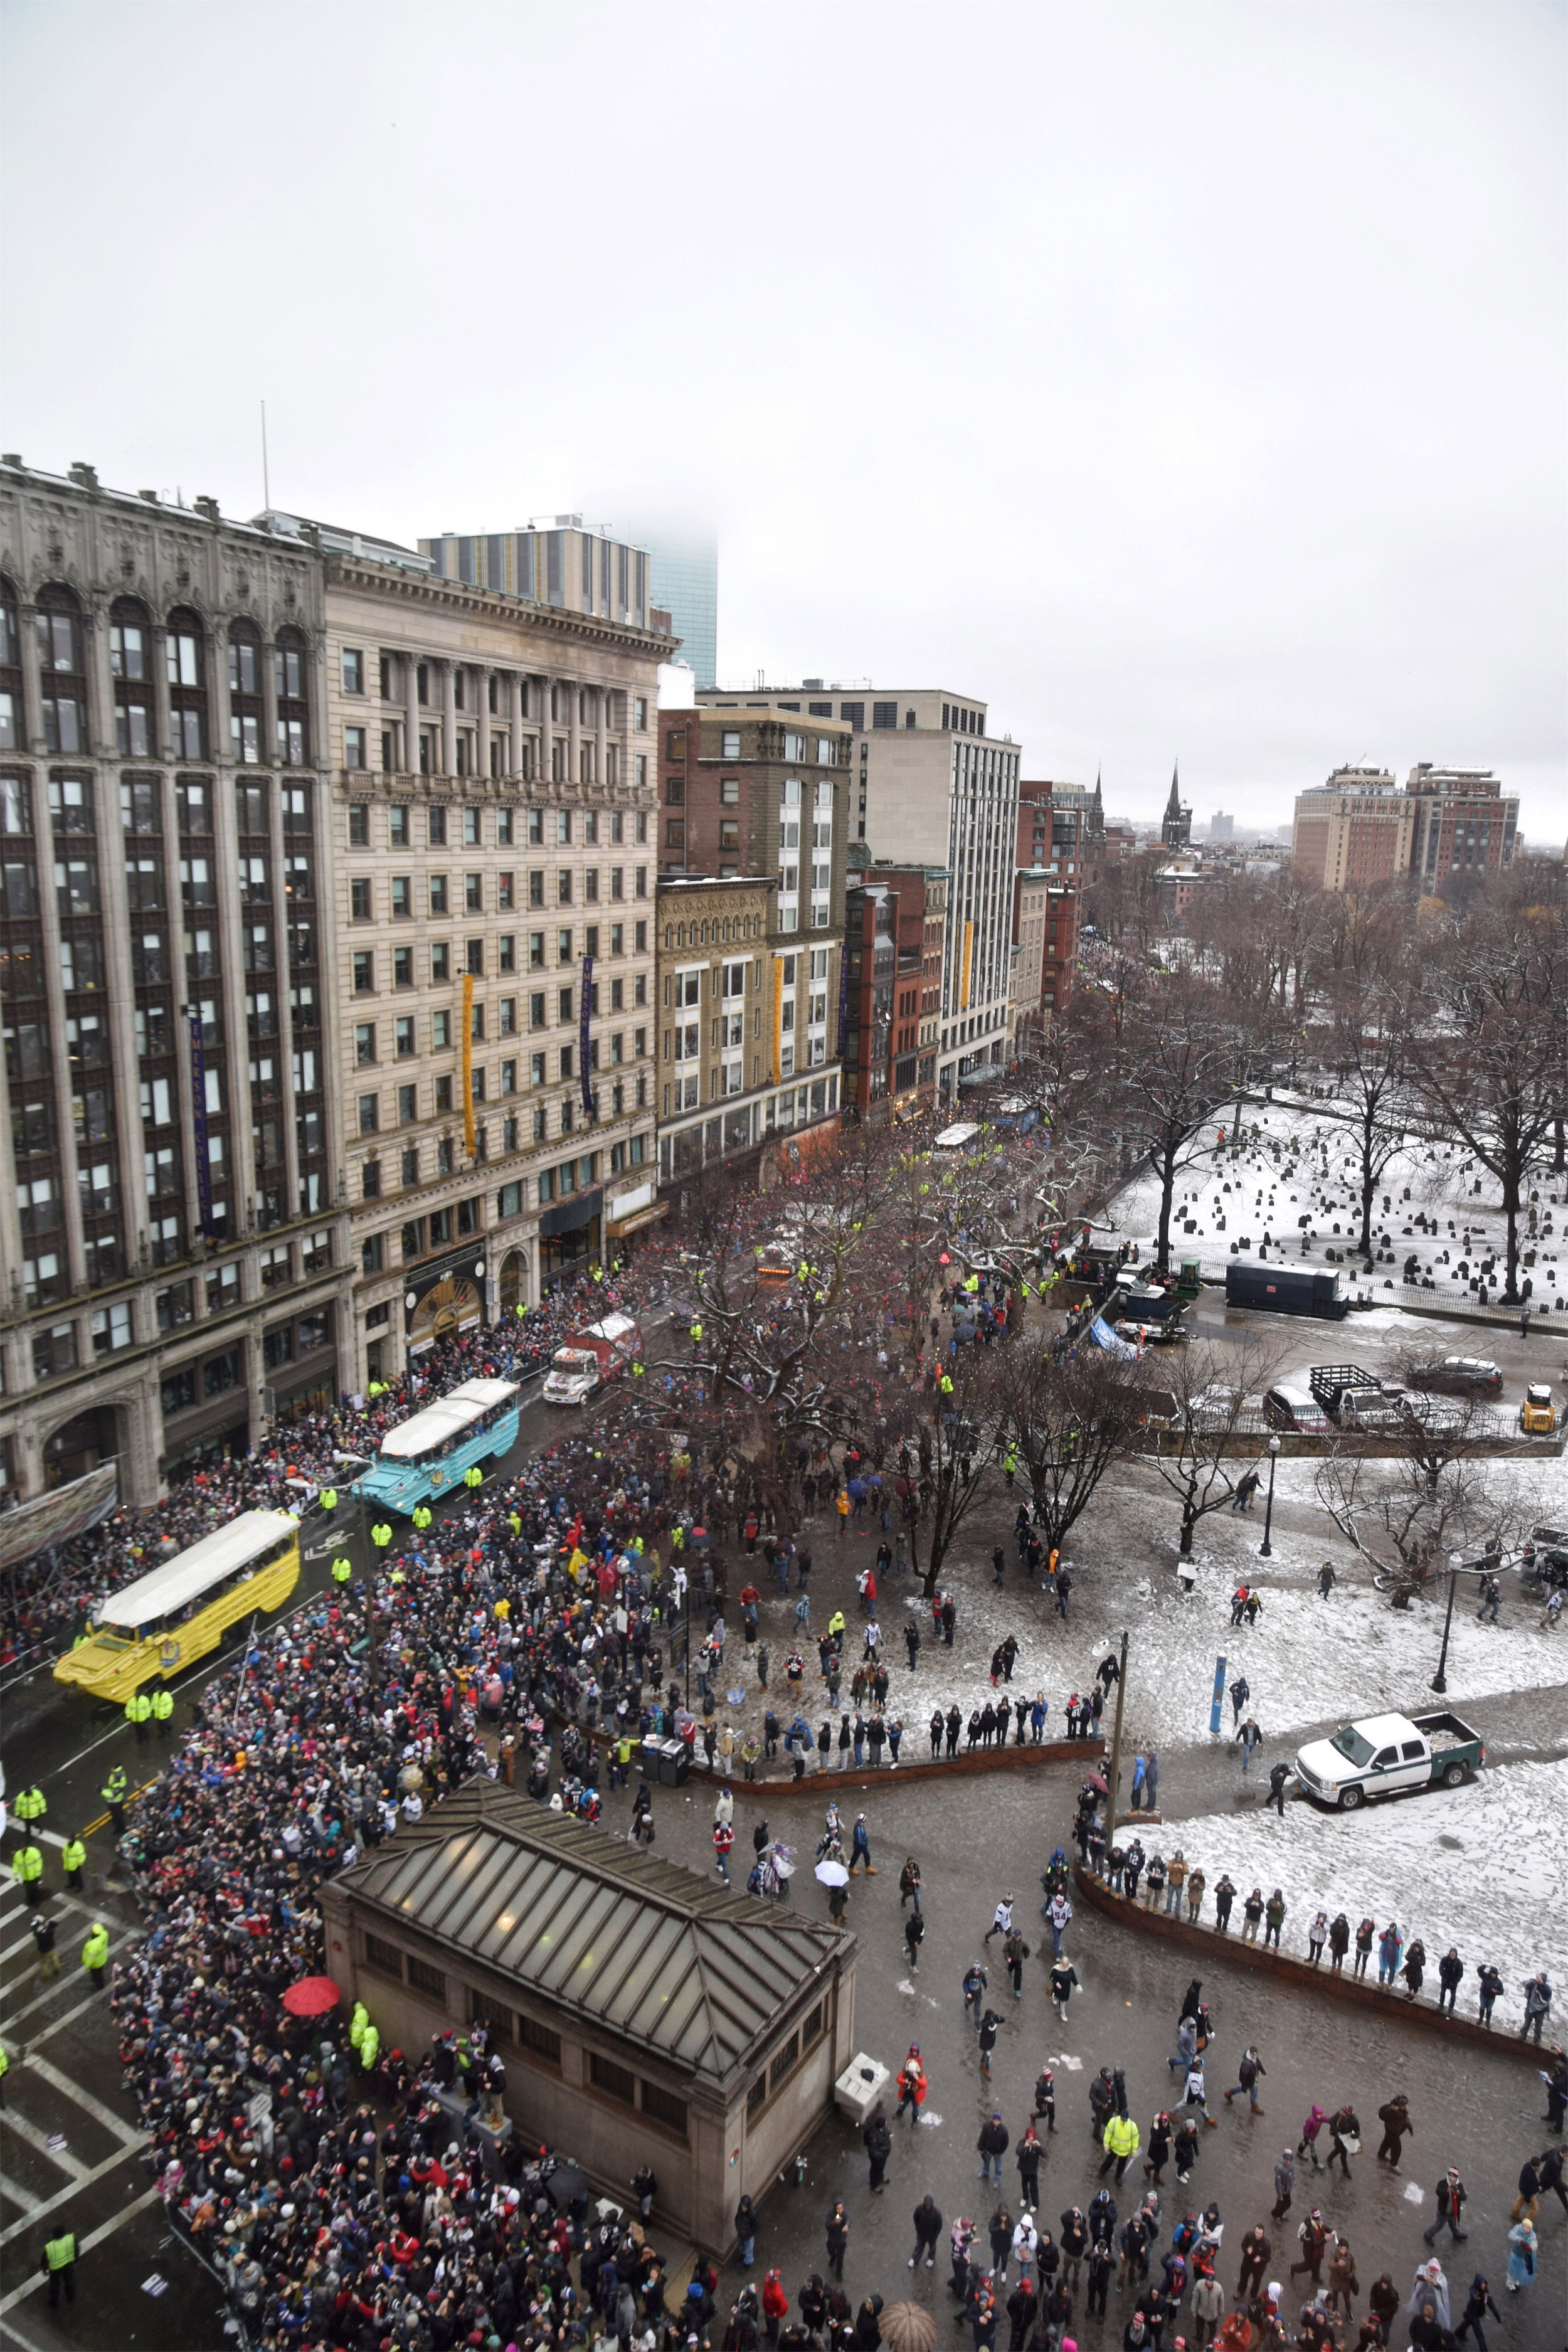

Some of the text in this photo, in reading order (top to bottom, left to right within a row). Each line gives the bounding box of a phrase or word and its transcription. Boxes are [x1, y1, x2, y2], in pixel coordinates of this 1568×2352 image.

[582, 963, 590, 1027] EMERSON
[191, 1024, 208, 1222] EMERSON COLLEGE
[790, 1663, 798, 1672] 12
[1129, 1853, 1139, 1866] 12
[1054, 1912, 1066, 1920] 54
